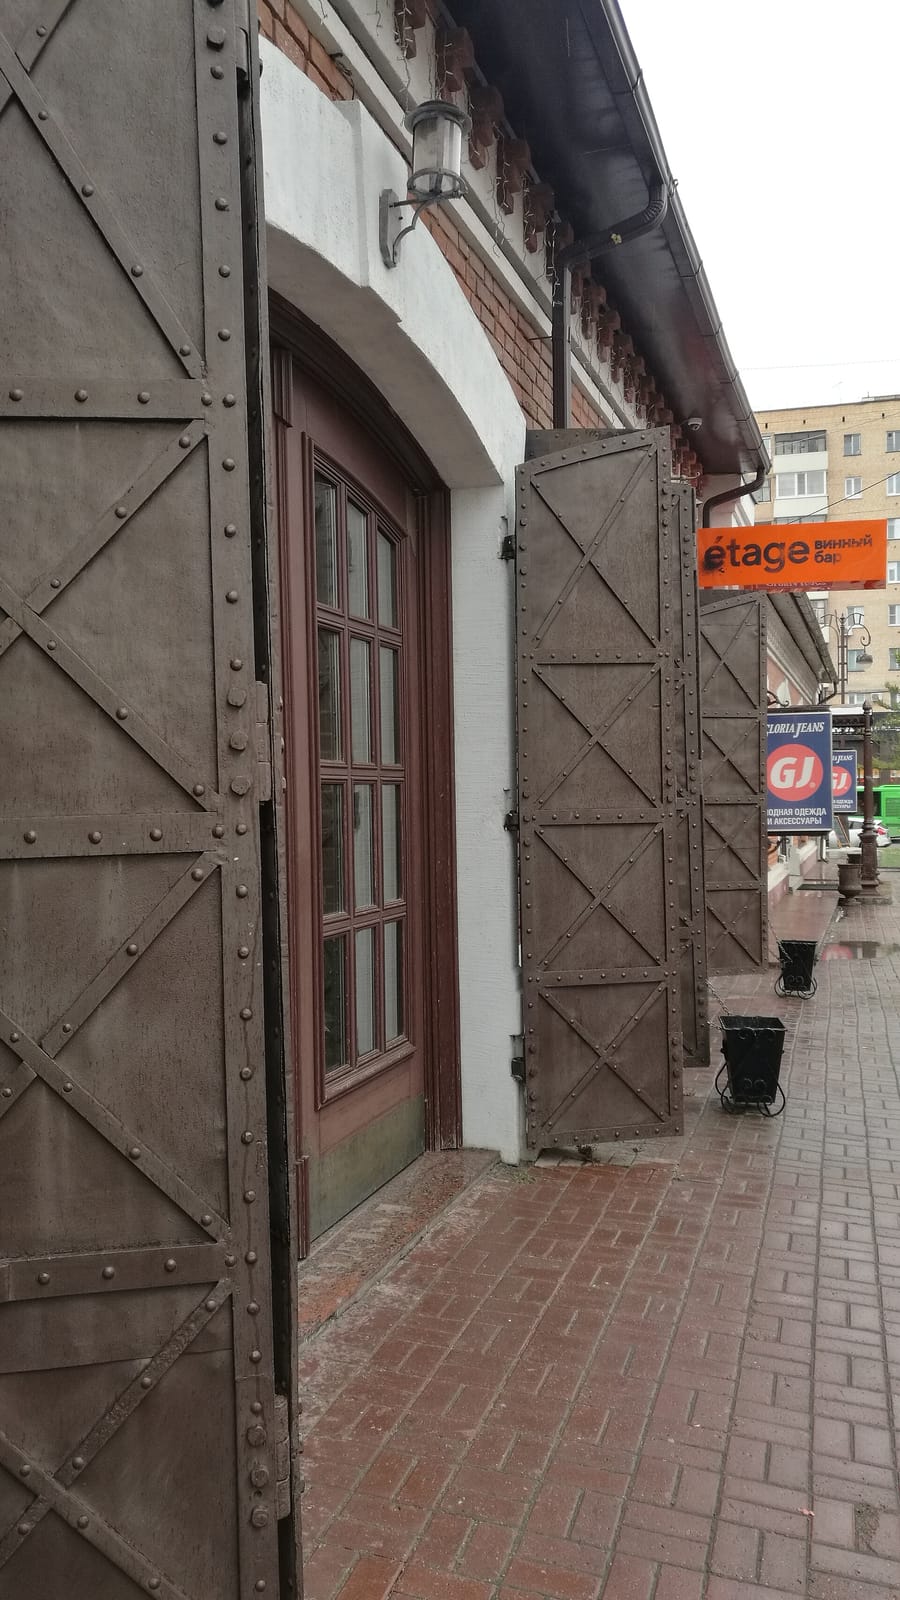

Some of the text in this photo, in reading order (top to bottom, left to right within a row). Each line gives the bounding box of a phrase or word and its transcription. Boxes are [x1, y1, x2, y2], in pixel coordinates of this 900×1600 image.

[814, 534, 873, 550] винный
[703, 536, 809, 573] étage
[814, 551, 841, 565] бар
[793, 722, 825, 738] JEANS
[766, 807, 827, 817] ОДНАЯ ОДЕЖДА
[767, 817, 822, 825] И АКСЕССУАРЫ
